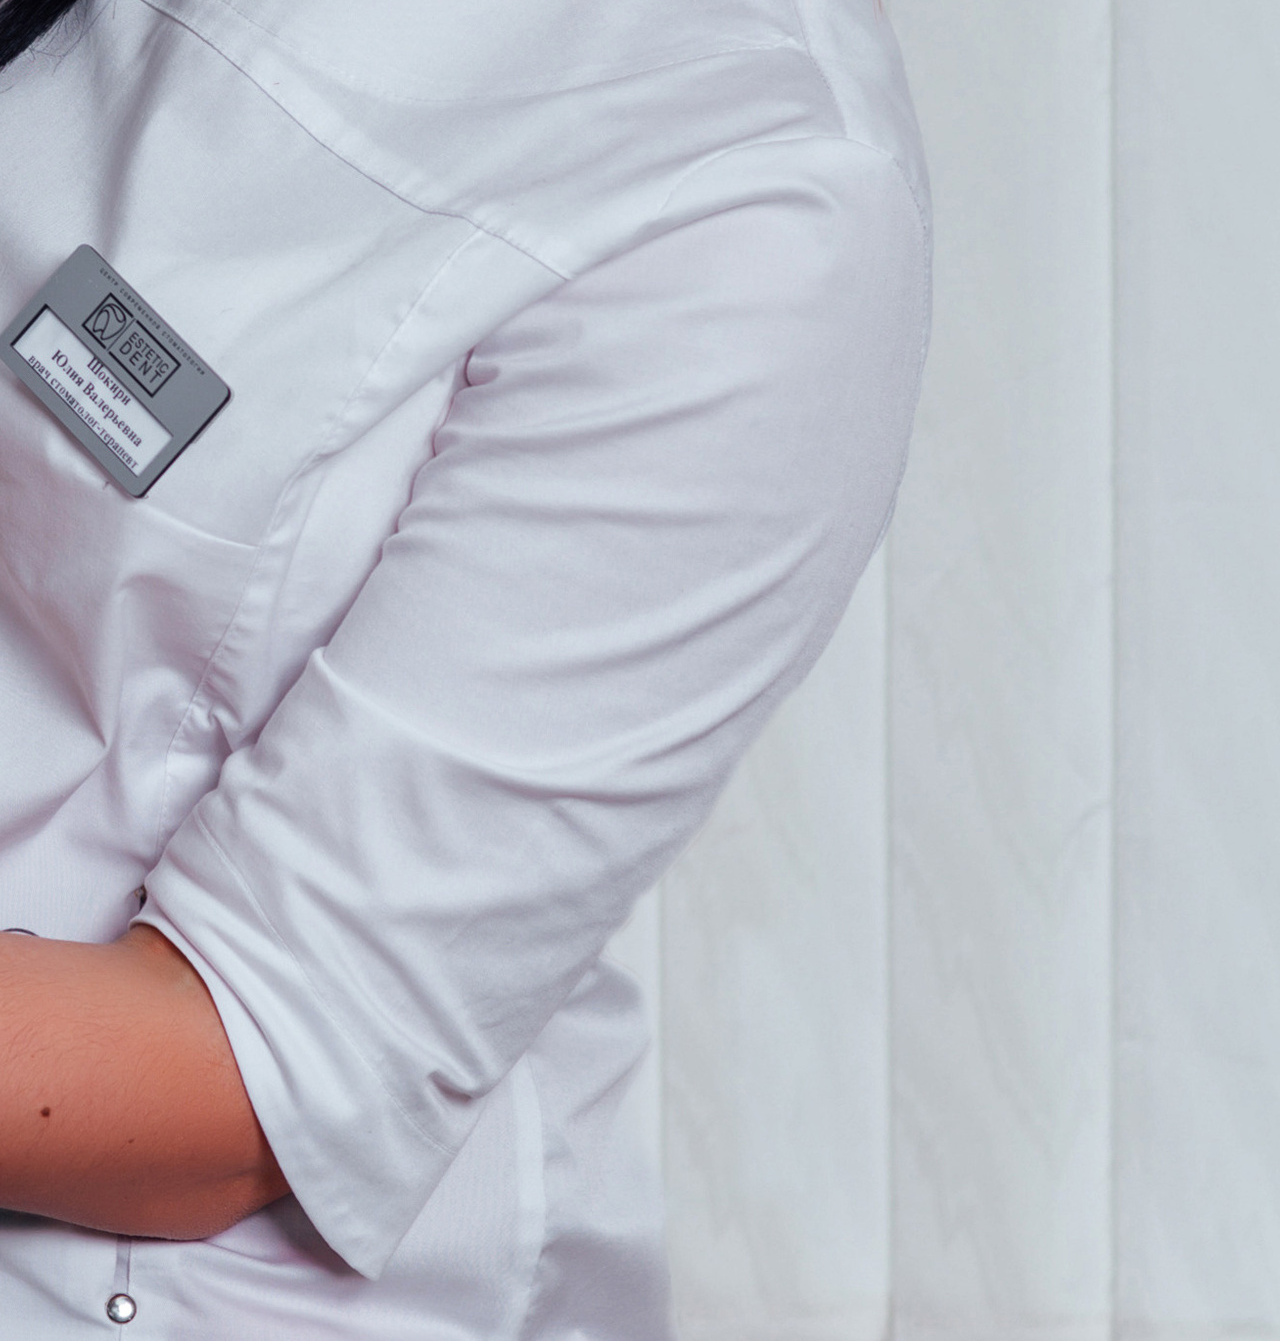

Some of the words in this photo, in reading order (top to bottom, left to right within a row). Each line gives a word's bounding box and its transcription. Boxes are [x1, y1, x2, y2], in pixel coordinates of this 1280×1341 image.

[119, 343, 165, 385] DENT
[128, 332, 169, 374] ESTETIC
[51, 349, 85, 387] Юлия
[82, 382, 143, 447] Валерьевна
[87, 357, 132, 406] Шокири
[28, 355, 52, 380] врач
[50, 377, 139, 469] стоматолог-терапевт
